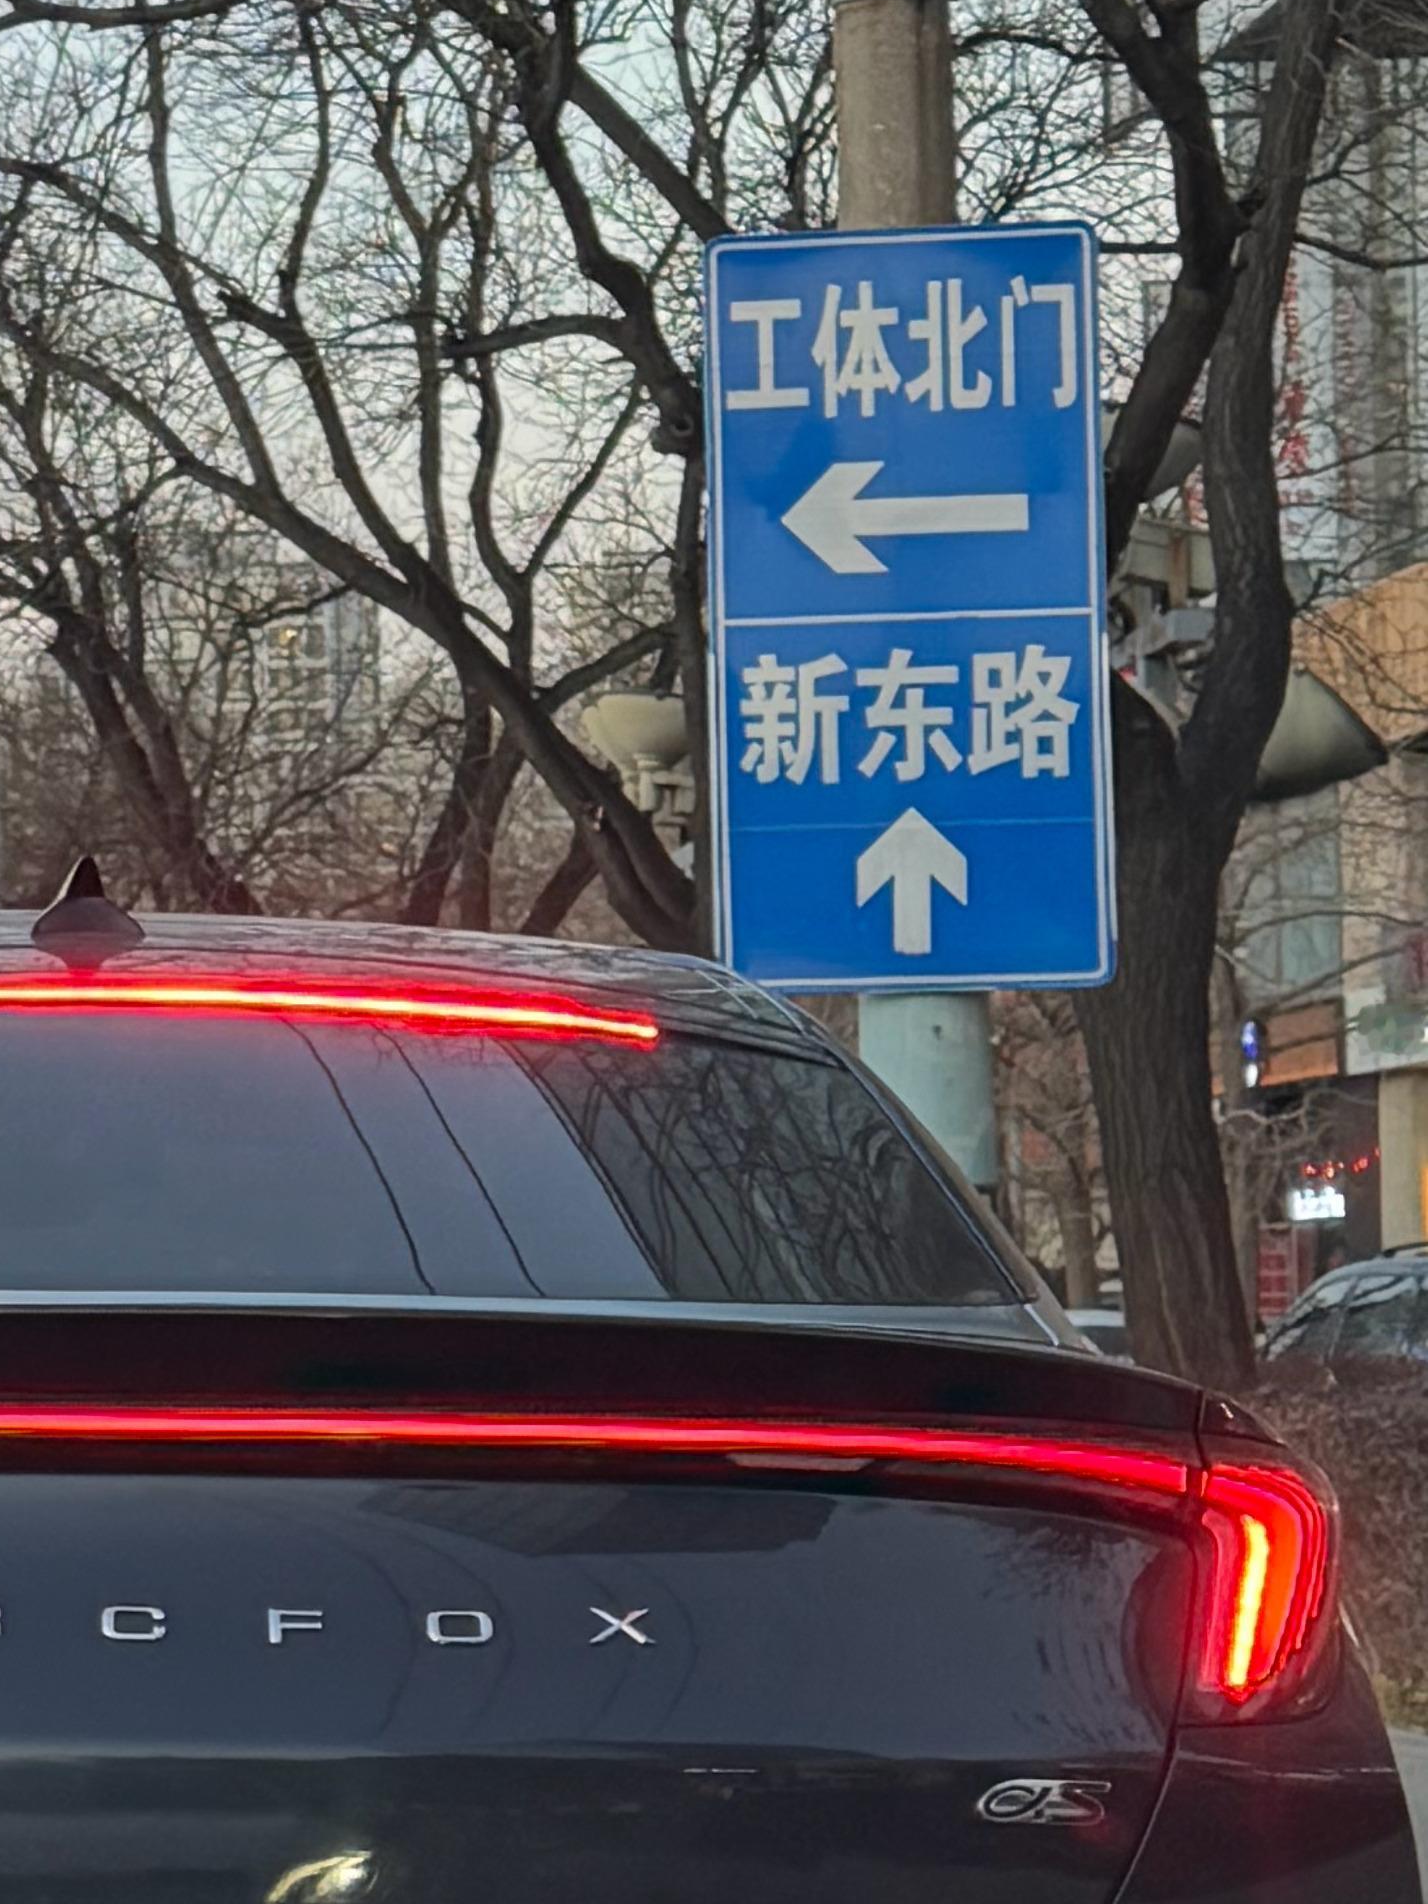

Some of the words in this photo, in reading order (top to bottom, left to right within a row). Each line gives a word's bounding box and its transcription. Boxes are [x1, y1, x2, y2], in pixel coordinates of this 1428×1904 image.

[726, 275, 1079, 419] 工体北门
[739, 643, 1081, 786] 新东路
